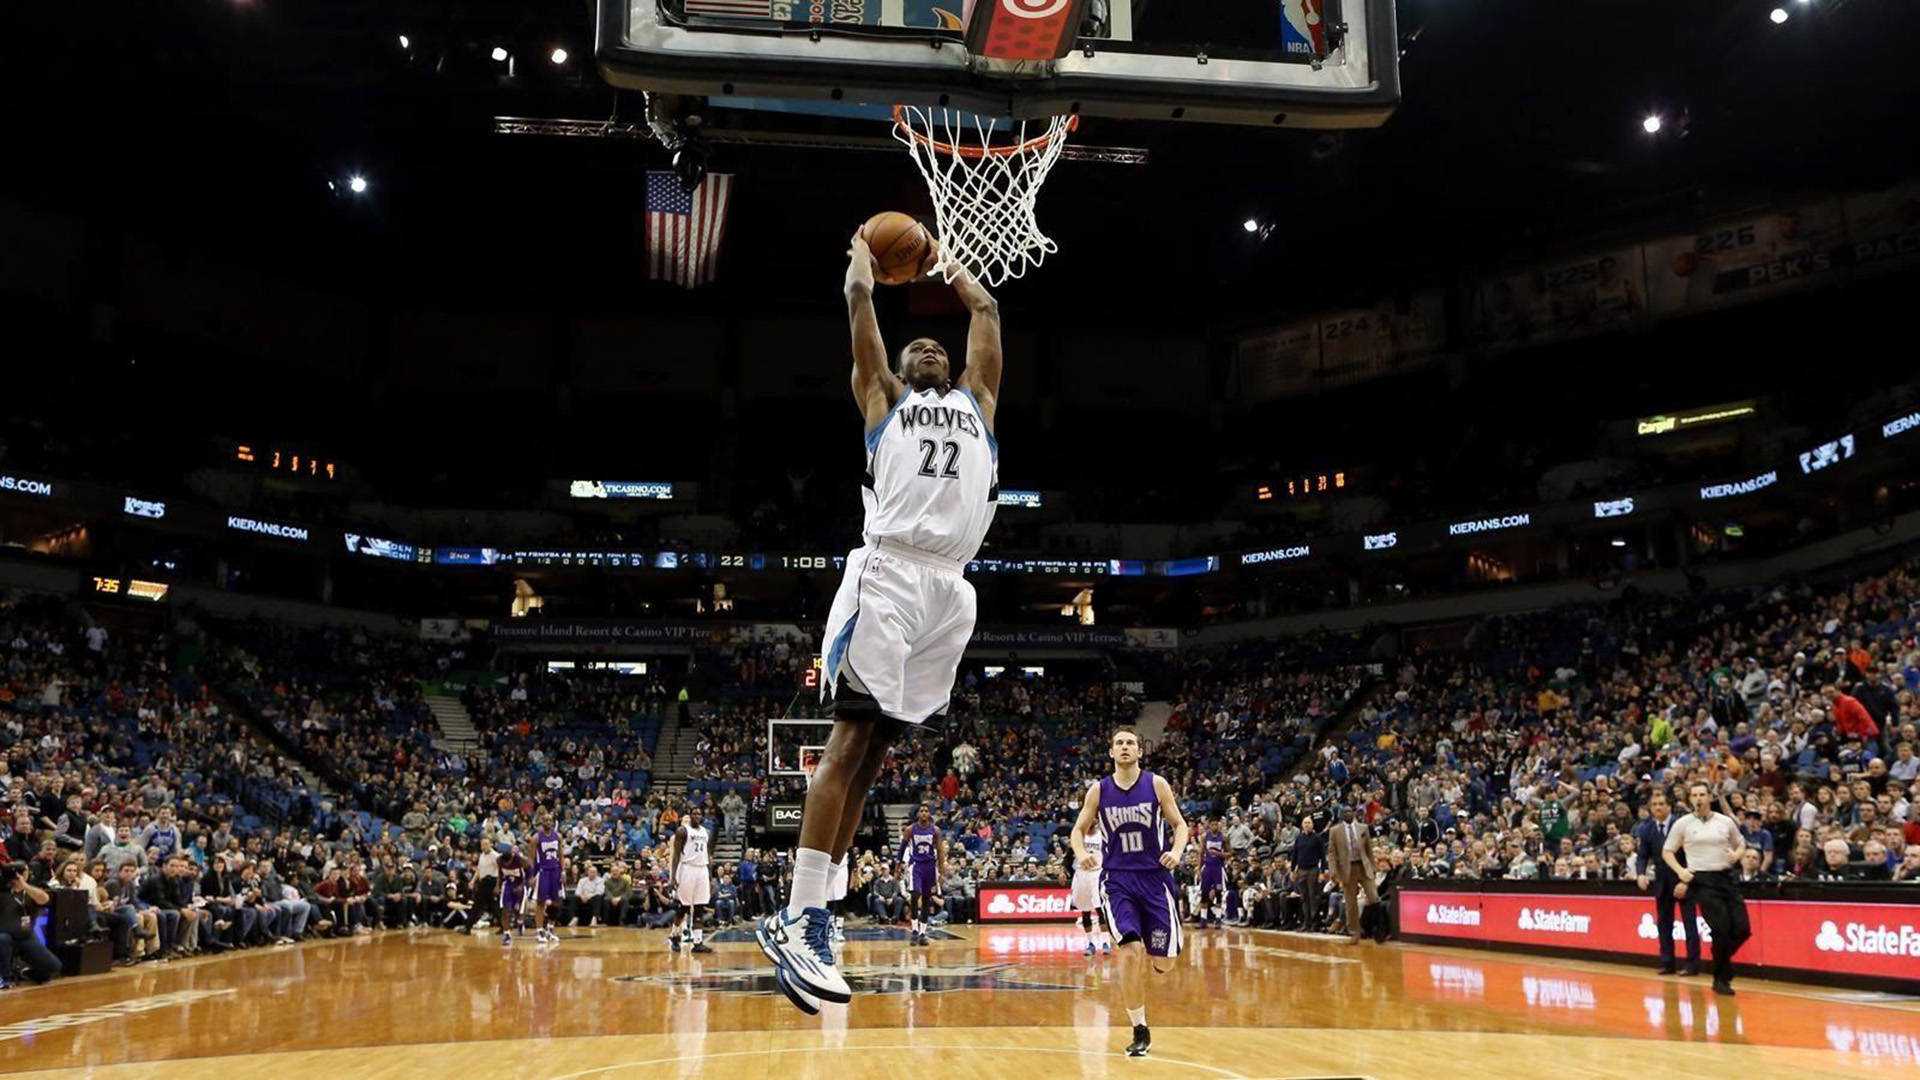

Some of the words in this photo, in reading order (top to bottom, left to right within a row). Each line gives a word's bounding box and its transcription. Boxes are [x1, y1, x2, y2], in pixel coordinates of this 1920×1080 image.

[1287, 41, 1310, 53] NBA
[898, 404, 979, 439] WOLVES
[918, 438, 961, 479] 22
[605, 484, 671, 494] TICASINO.COM
[1700, 471, 1777, 499] KIERANS.COM
[998, 493, 1039, 502] SINO.COM
[228, 516, 308, 540] KIERANS.COM
[1449, 513, 1529, 535] KIERANS.COM
[721, 555, 744, 566] 22
[782, 556, 826, 568] 1:08
[1241, 546, 1310, 564] KIERANS.COM
[93, 577, 120, 593] 7:35
[540, 624, 574, 637] Island
[575, 624, 609, 637] Resort
[611, 625, 622, 637] &
[625, 625, 662, 638] Casino
[664, 626, 686, 637] VIP
[983, 631, 1015, 642] Resort
[1017, 632, 1028, 642] &
[1029, 632, 1063, 643] Casino
[1065, 632, 1085, 642] VIP
[775, 809, 801, 820] BAC
[1105, 802, 1152, 832] KINGS
[1119, 831, 1144, 853] 10
